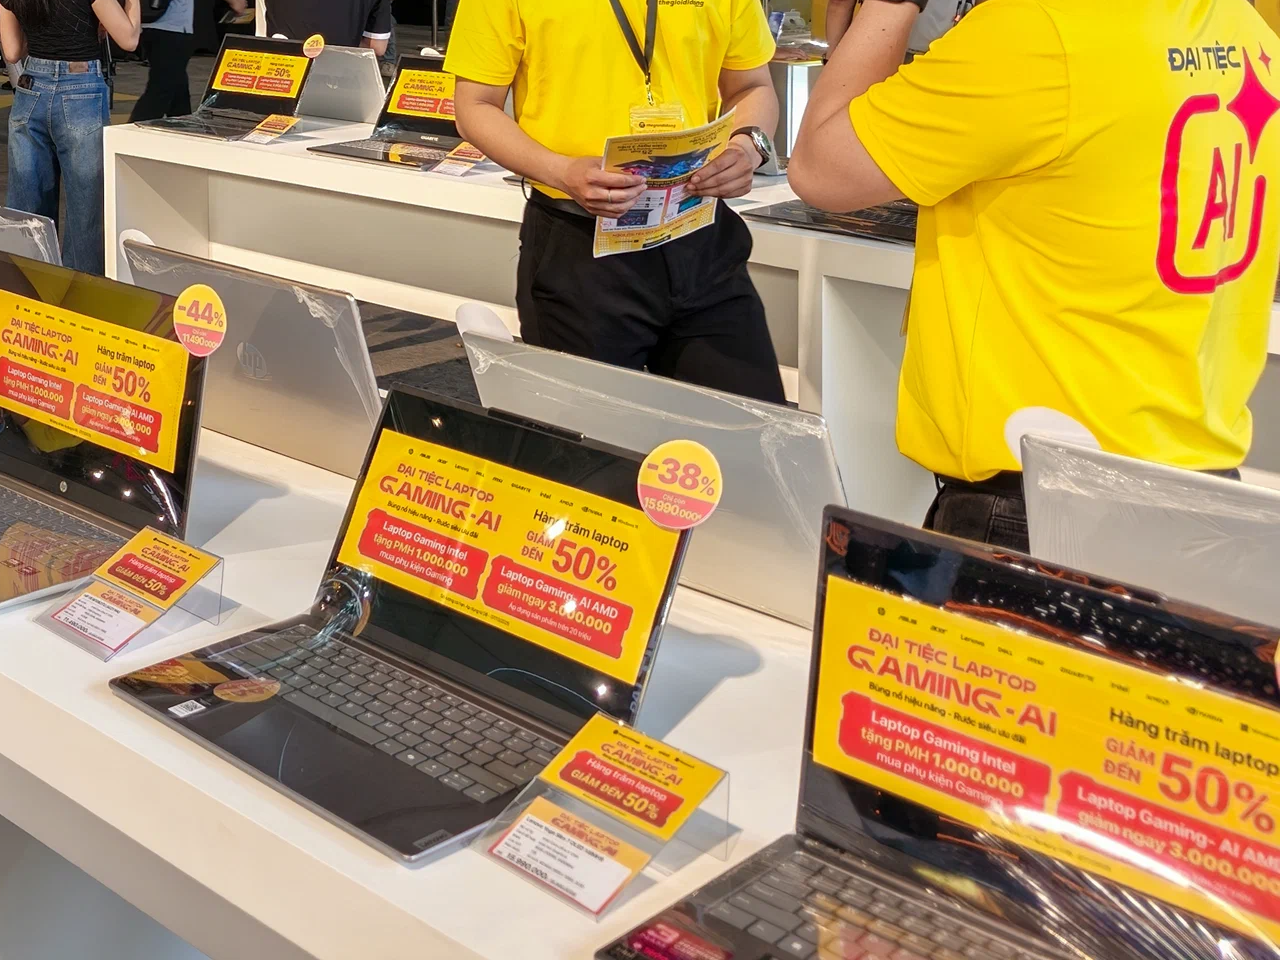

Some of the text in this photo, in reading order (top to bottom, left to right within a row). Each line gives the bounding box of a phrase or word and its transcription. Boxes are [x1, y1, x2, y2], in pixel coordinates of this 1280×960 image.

[1168, 41, 1240, 77] ĐẠI TIỆC
[1192, 143, 1242, 250] AI
[11, 318, 72, 343] ĐẠI TIỆC LAPTOP
[178, 300, 223, 327] -44%
[2, 329, 78, 366] GAMING-AI
[97, 345, 155, 371] Hàng trăm laptop
[8, 366, 62, 390] Laptop Gaming Intel
[93, 374, 106, 386] ĐẾN
[95, 362, 112, 375] GIẢM
[112, 366, 150, 402] 50%
[16, 380, 29, 391] PMH
[30, 385, 63, 403] 1.000.000
[38, 400, 55, 412] Gaming
[83, 392, 103, 406] Laptop
[139, 413, 154, 423] AMD
[82, 405, 113, 422] giảm ngay
[398, 463, 494, 502] ĐẠI TIỆC LAPTOP
[647, 458, 715, 496] -38%
[379, 475, 502, 532] GAMING-AI
[387, 501, 400, 511] Bùng
[374, 533, 468, 577] tặng PMH 1.000.000
[383, 521, 468, 560] Laptop Gaming Intel
[522, 545, 544, 562] ĐẾN
[526, 530, 554, 549] GIẢM
[565, 521, 628, 553] trăm laptop
[128, 558, 144, 569] Hàng
[156, 570, 176, 584] laptop
[380, 550, 453, 586] mua phụ kiện Gaming
[552, 538, 617, 591] 50%
[145, 578, 167, 595] 50%
[498, 582, 520, 599] giảm
[522, 593, 546, 610] ngay
[500, 565, 618, 619] Laptop AI AMD
[868, 628, 1037, 693] ĐẠI TIỆC LAPTOP
[869, 681, 976, 727] Bùng nổ hiệu năng Rước
[871, 710, 1016, 774] Laptop Gaming Intel
[1105, 736, 1155, 766] GIẢM
[1109, 706, 1280, 777] Hàng trăm laptop
[586, 758, 612, 776] Hàng
[613, 771, 636, 786] trăm
[635, 779, 667, 802] laptop
[861, 726, 1024, 798] tặng PMH 1.000.000
[877, 751, 953, 789] mua phụ kiện
[1103, 758, 1141, 785] ĐẾN
[571, 769, 601, 788] GIẢM
[622, 792, 659, 820] 50%
[1158, 752, 1275, 834] 50%
[1077, 786, 1239, 857] Laptop AI
[1078, 810, 1119, 837] giảm
[1122, 827, 1166, 855] ngay
